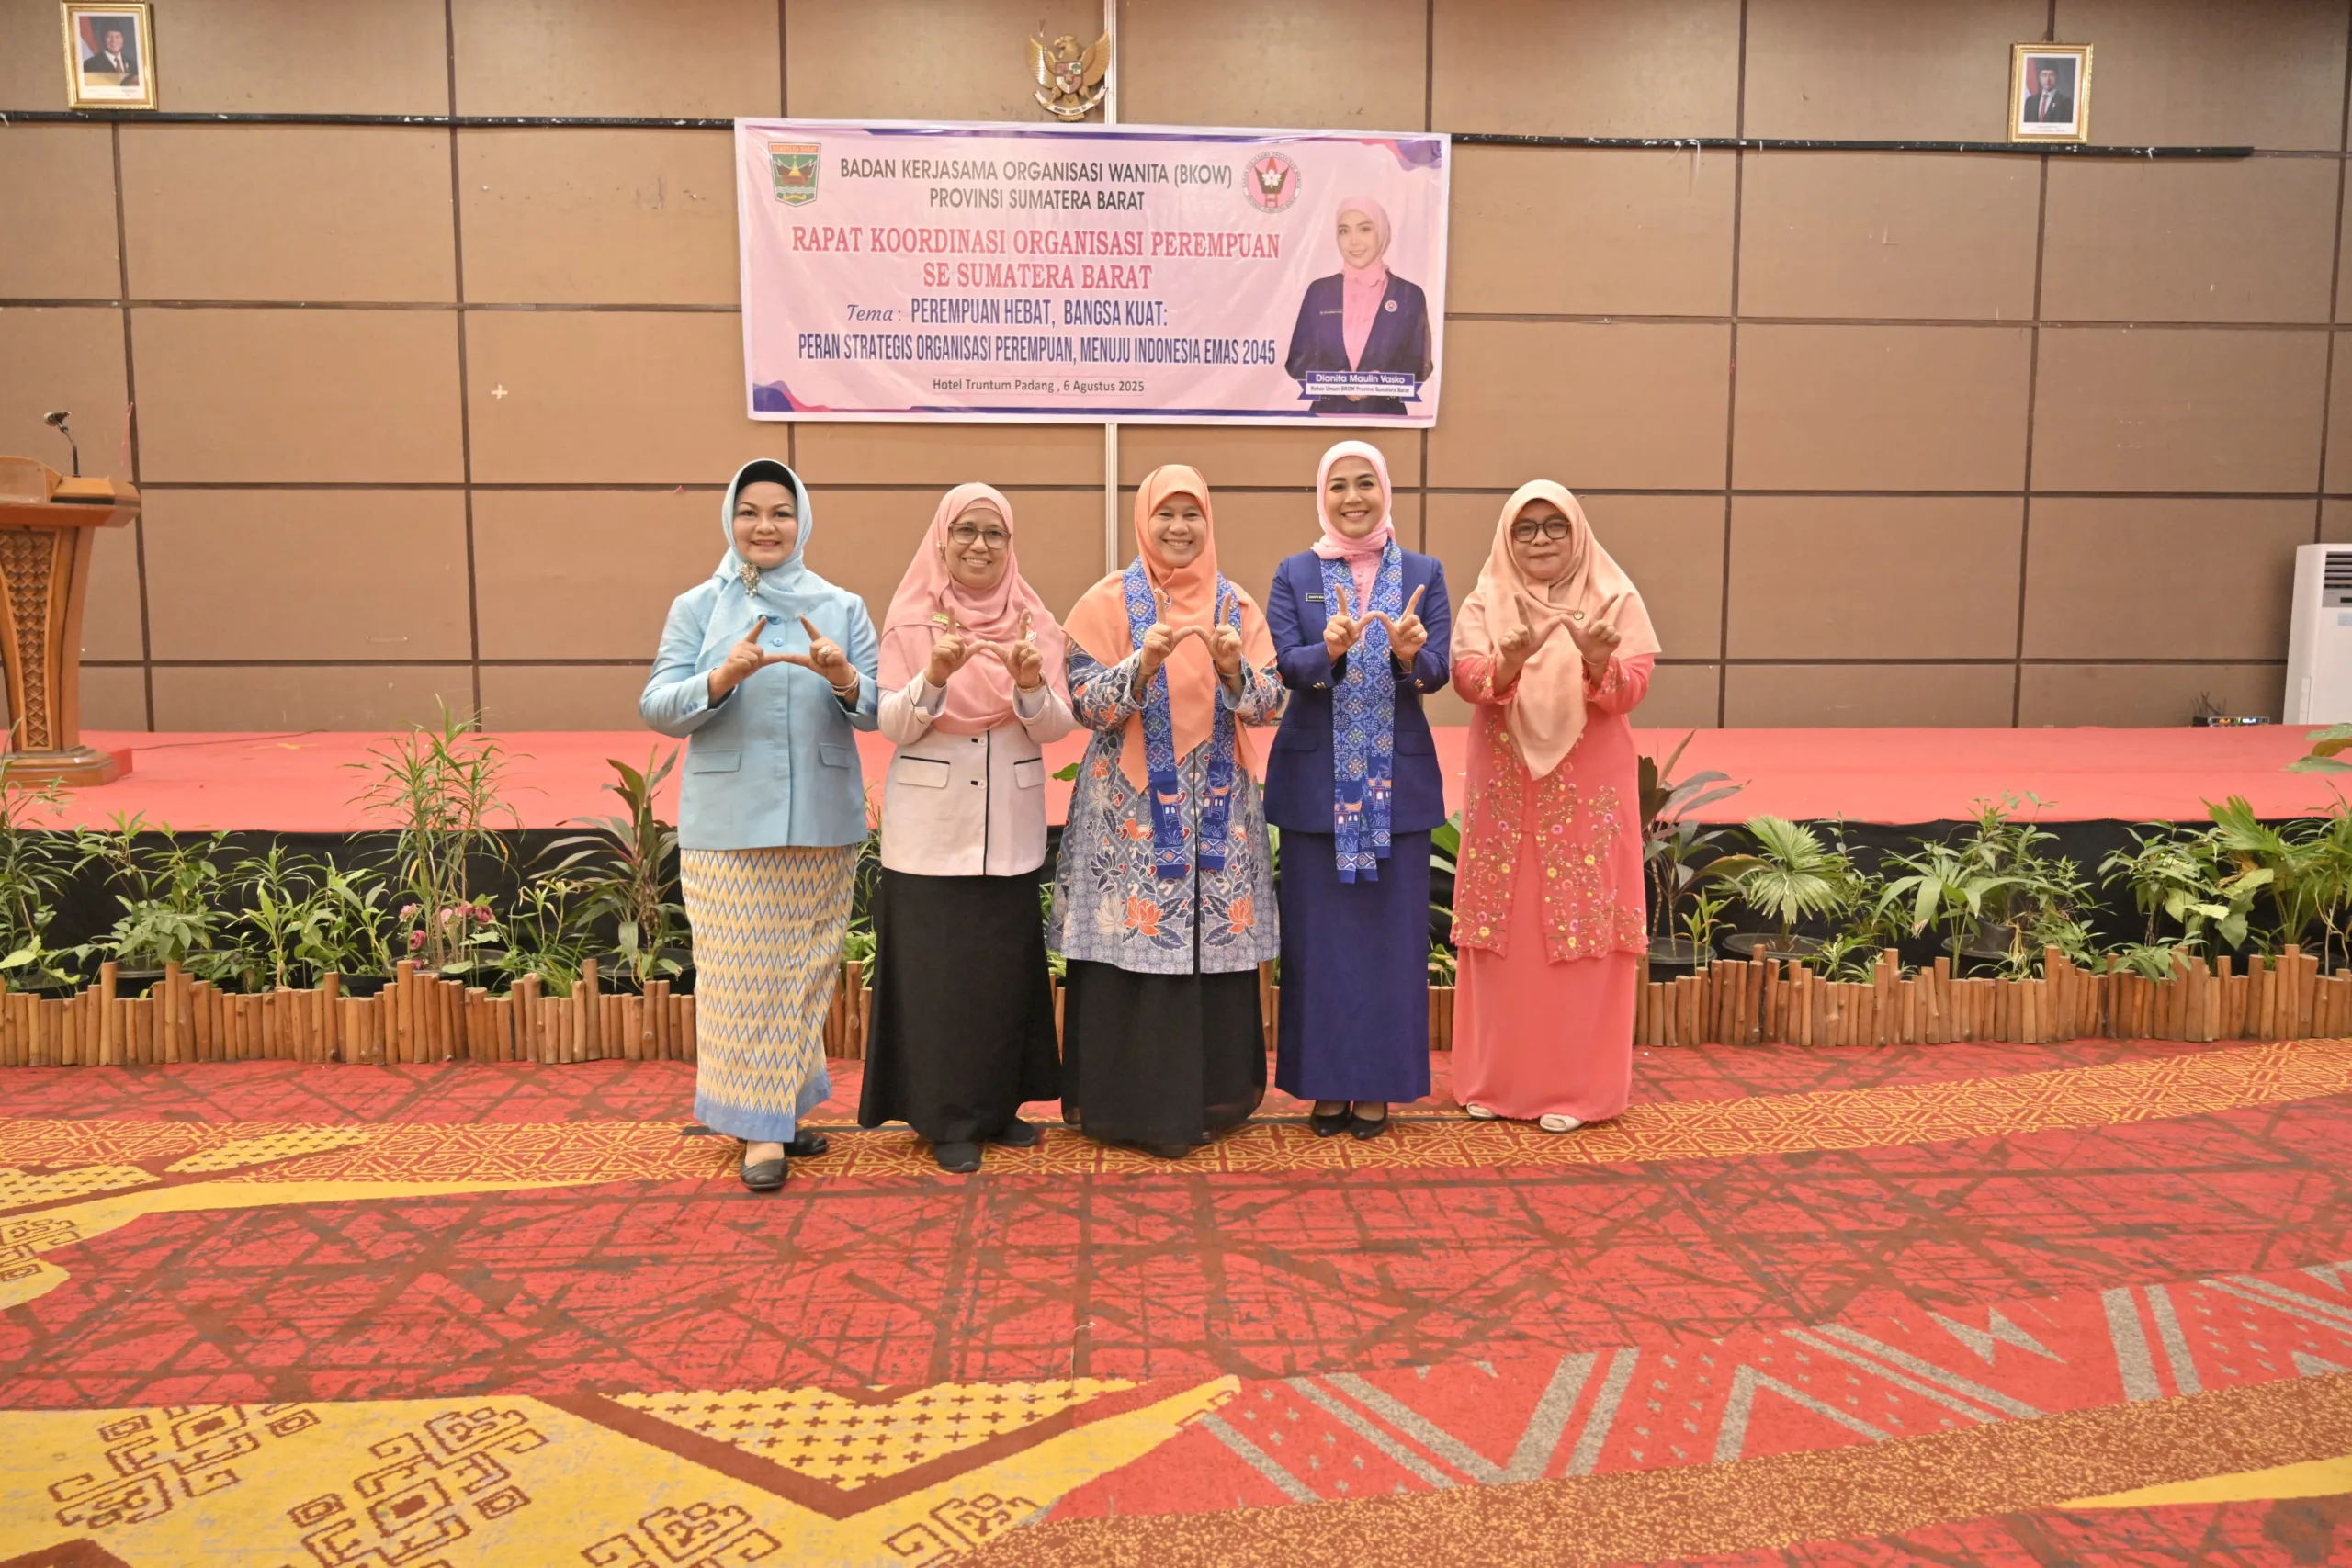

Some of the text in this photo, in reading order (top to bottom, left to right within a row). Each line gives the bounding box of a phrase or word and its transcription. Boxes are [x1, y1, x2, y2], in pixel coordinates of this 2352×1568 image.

[841, 158, 1232, 189] BADAN KERJASAMA ORGANISASI WANITA (BKOW)
[930, 187, 1145, 210] PROVINSI SUMATERA BARAT
[792, 226, 1280, 259] RAPAT KOORDINASI ORGANISASI PEREMPUAN
[923, 262, 1152, 290] SE SUMATERA BARAT
[911, 298, 1000, 324] PEREMPUAN
[1004, 299, 1056, 328] HEBAT,
[1064, 299, 1121, 326] BANGSA
[1125, 301, 1168, 326] KUAT:
[798, 333, 1275, 366] PERAN STRATEGIS ORGANISASI PEREMPUAN, MENUJU INDONESIA EMAS 2045
[933, 378, 962, 390] Hotel
[965, 379, 1012, 390] Truntum
[1063, 380, 1070, 391] 6
[1073, 380, 1115, 393] Agustus
[1118, 381, 1145, 391] 2025
[1316, 374, 1405, 384] Dianita Maulin Vasko
